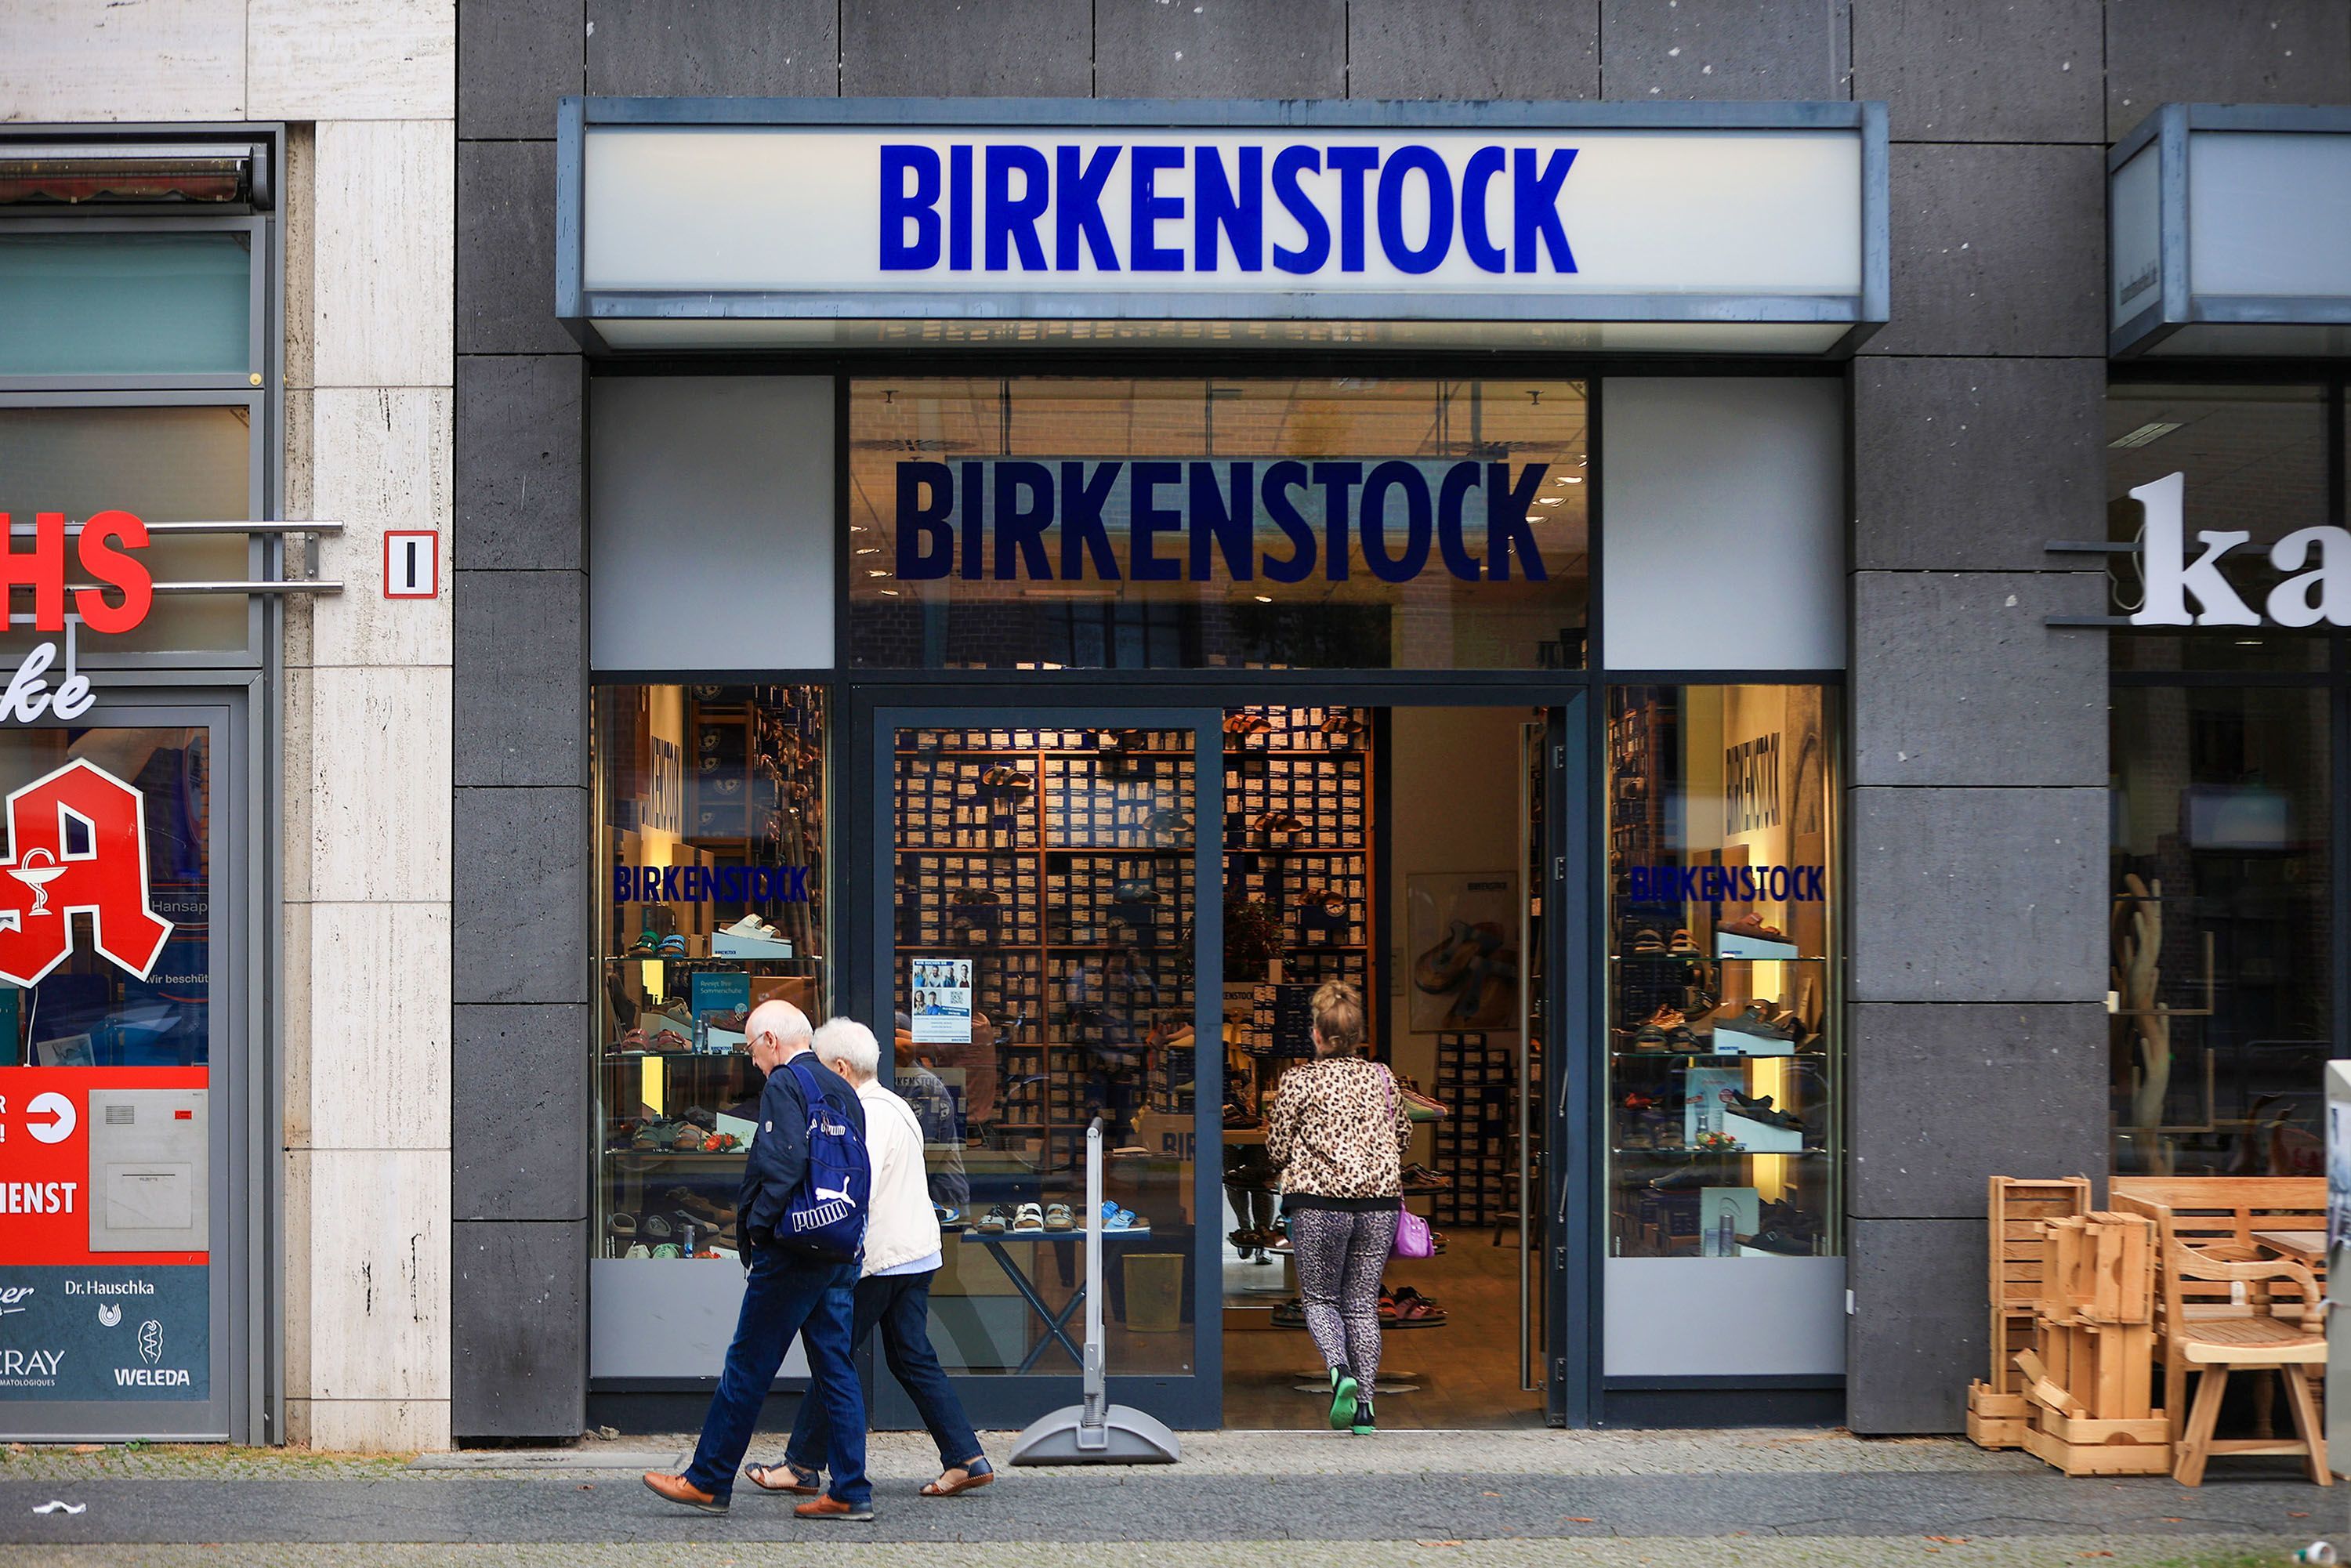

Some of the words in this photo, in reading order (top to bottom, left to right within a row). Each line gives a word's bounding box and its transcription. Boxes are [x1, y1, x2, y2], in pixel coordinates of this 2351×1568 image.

[880, 145, 1579, 274] BIRKENSTOCK
[896, 461, 1549, 583] BIRKENSTOCK
[614, 865, 810, 902] BIRKENSTOCK
[1631, 865, 1824, 902] BIRKENSTOCK
[792, 1200, 848, 1233] PUMA
[0, 1286, 35, 1304] er
[65, 1280, 85, 1295] Dr.
[87, 1280, 154, 1295] Hauschka
[0, 1349, 66, 1376] RAY
[114, 1368, 190, 1386] WELEDA
